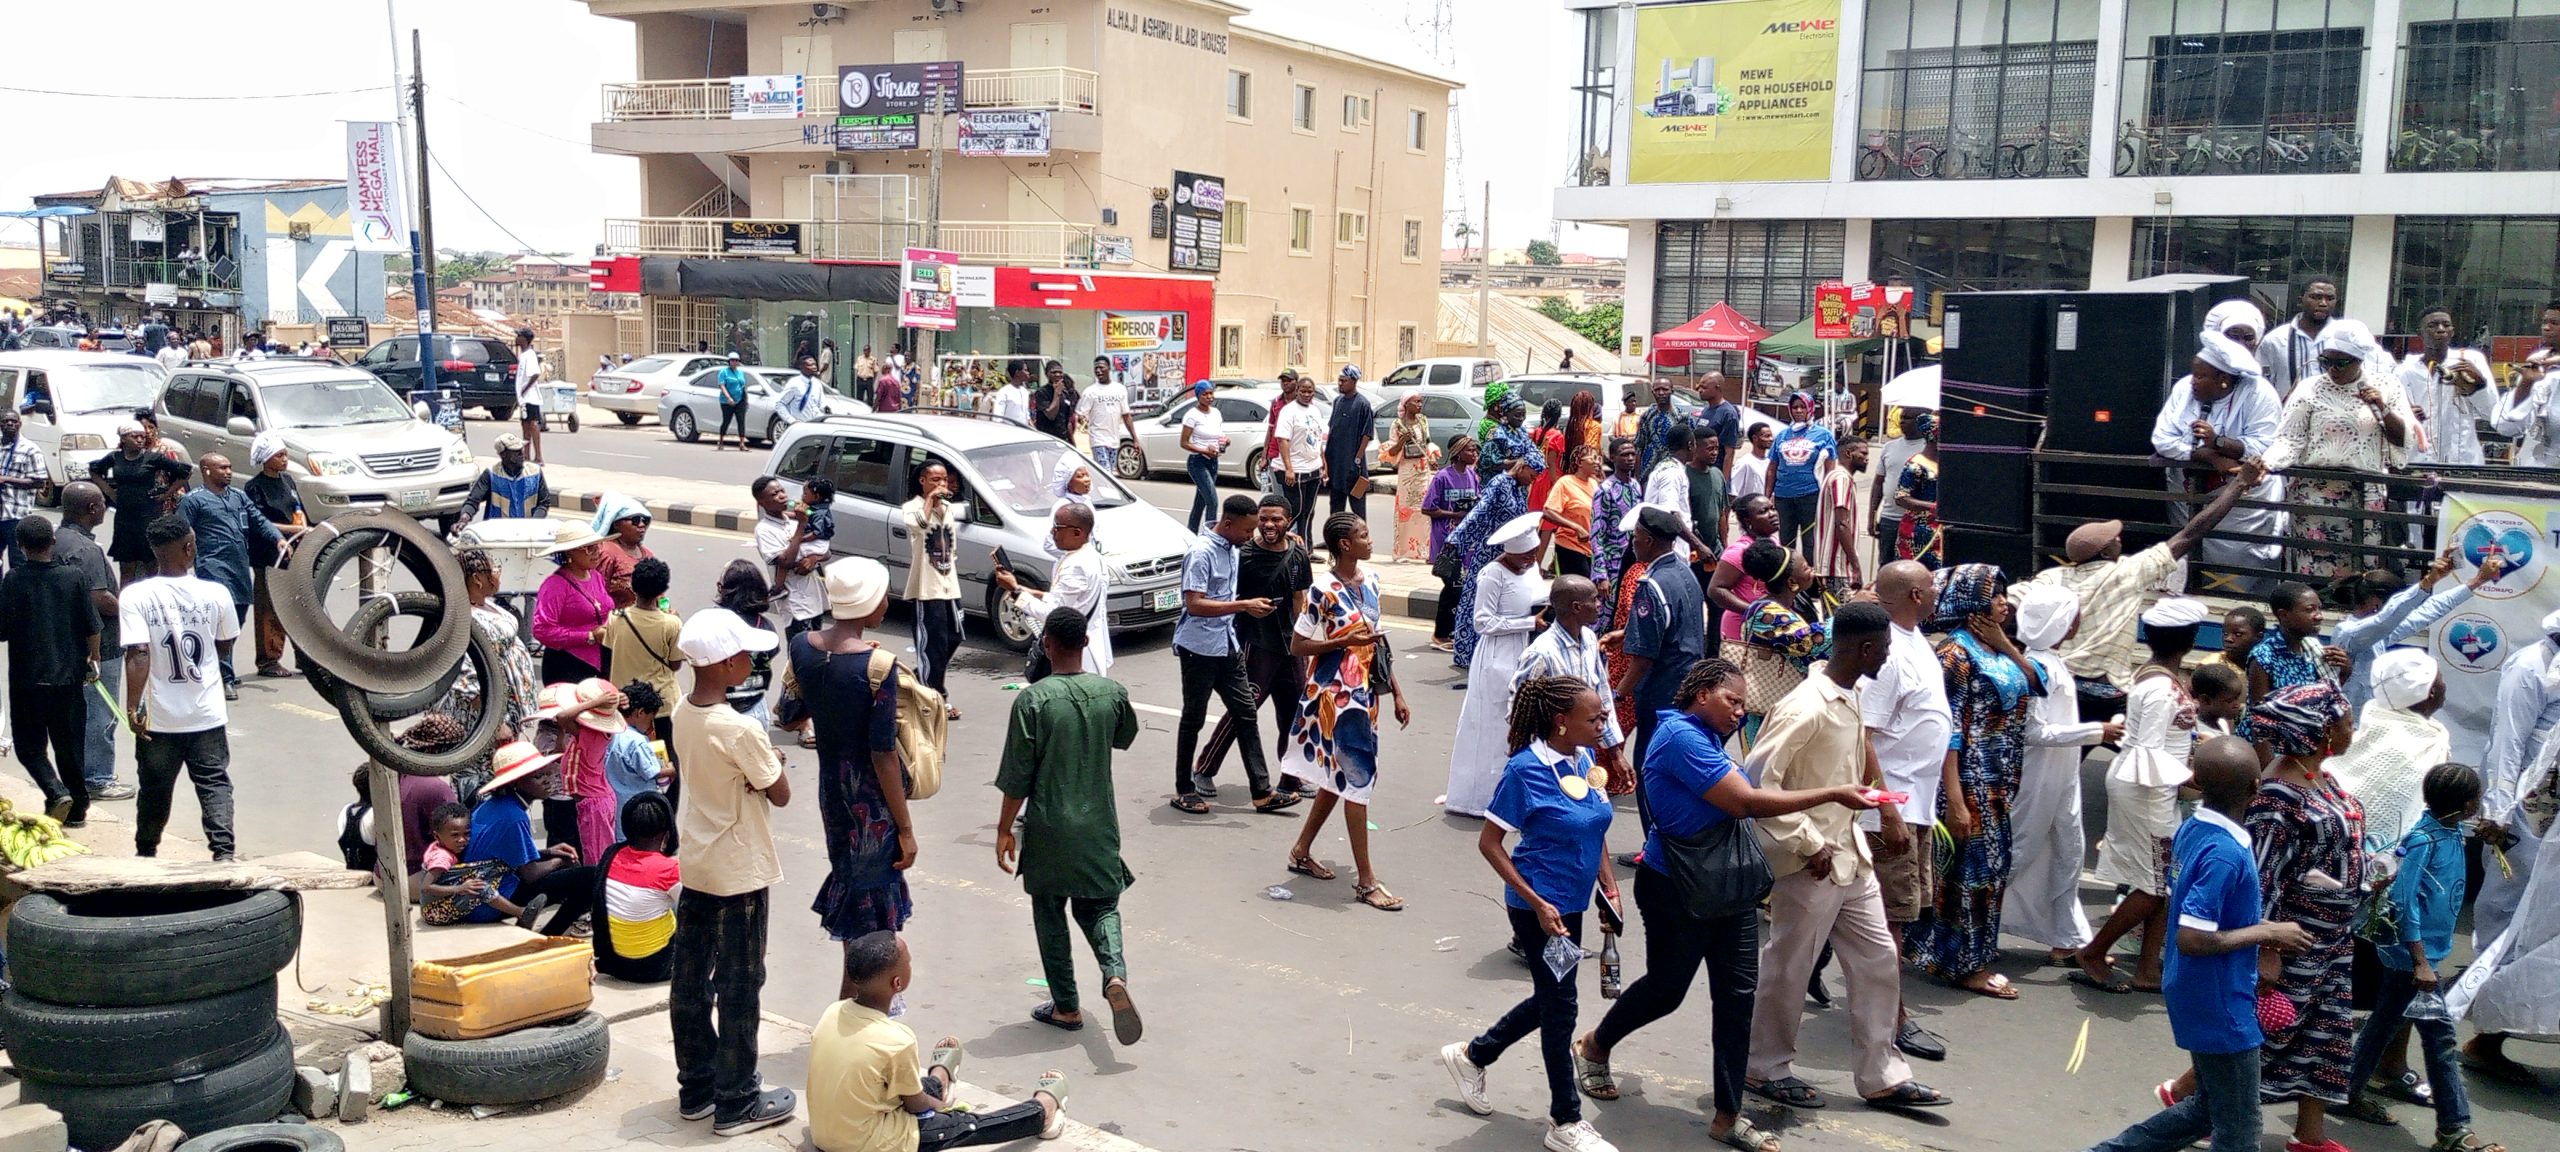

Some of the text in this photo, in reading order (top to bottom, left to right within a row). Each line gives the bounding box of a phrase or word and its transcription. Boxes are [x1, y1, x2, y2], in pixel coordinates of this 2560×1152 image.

[1107, 8, 1227, 55] ALHAJI ASHIRU ALABI HOUSE
[1800, 32, 1834, 41] Electronics
[1740, 69, 1774, 80] MEWE
[1739, 80, 1834, 95] FOR HOUSEHOLD
[1738, 97, 1808, 111] APPLIANCES
[973, 114, 1029, 123] ELEGANCE
[368, 123, 381, 164] MALL
[356, 140, 372, 211] MAMTESS
[369, 167, 385, 212] MEGA
[731, 222, 790, 235] SACYO
[1106, 321, 1156, 336] EMPEROR
[161, 630, 204, 683] 19
